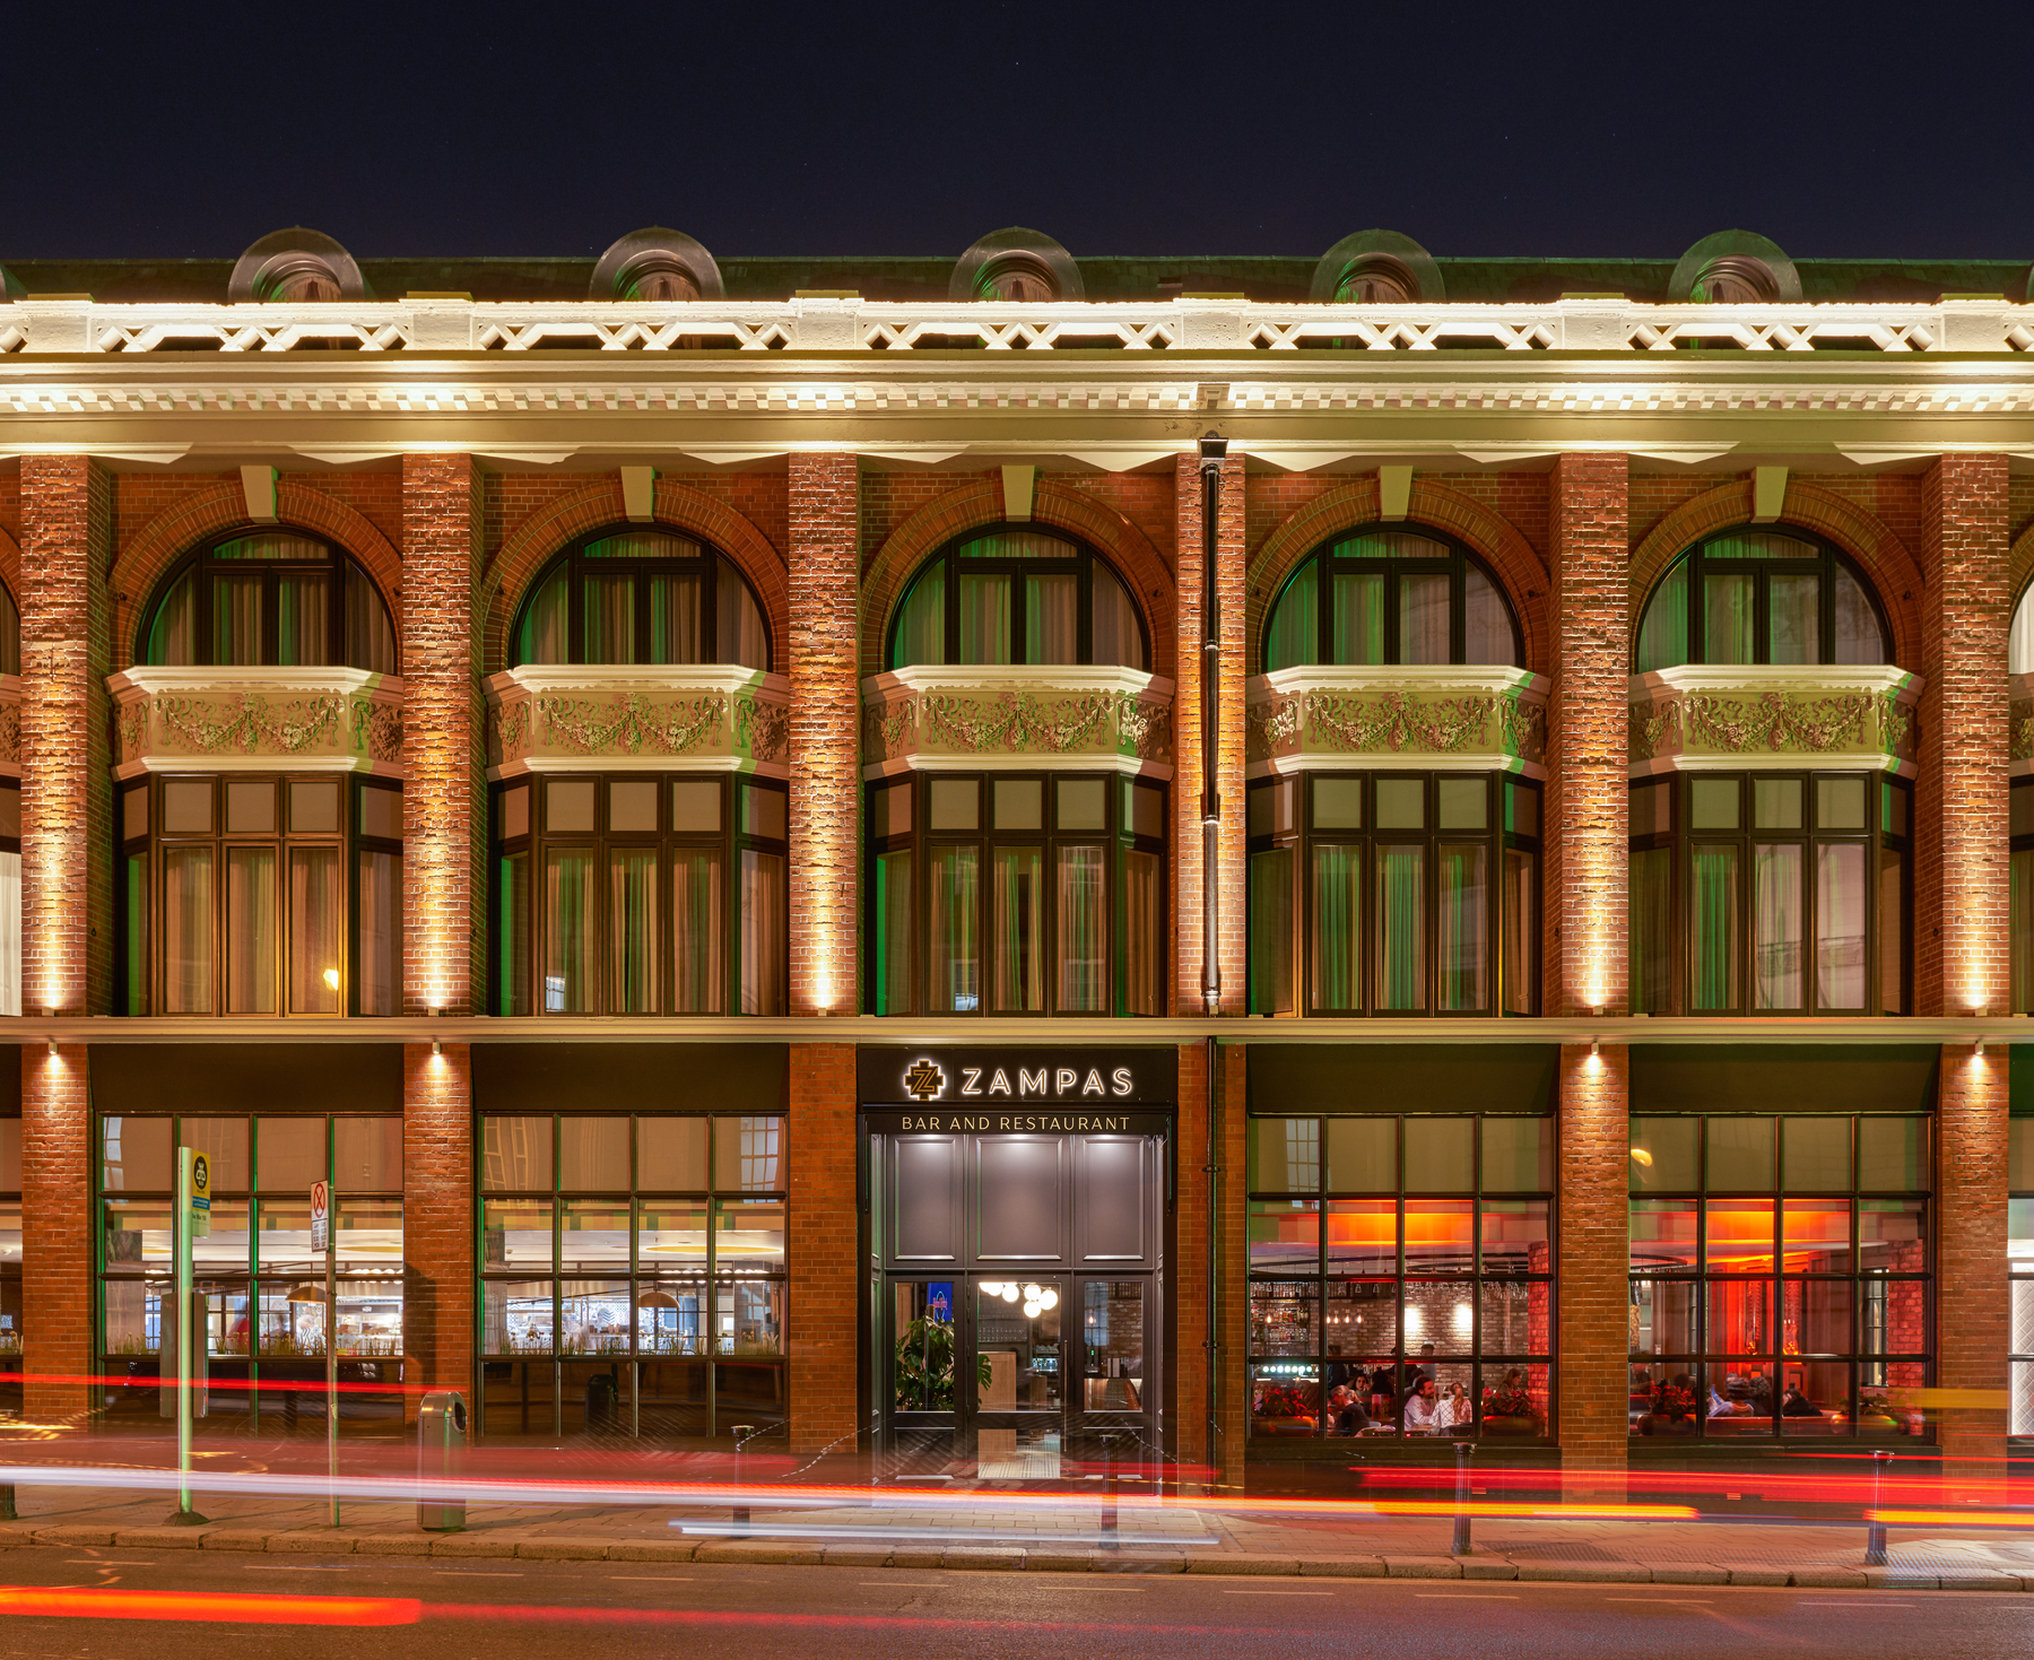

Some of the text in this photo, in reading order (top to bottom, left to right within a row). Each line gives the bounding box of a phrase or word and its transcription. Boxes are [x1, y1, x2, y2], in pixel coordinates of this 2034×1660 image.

[962, 1068, 1133, 1095] ZAMPAS
[902, 1117, 1130, 1130] BAR AND RESTAURANT
